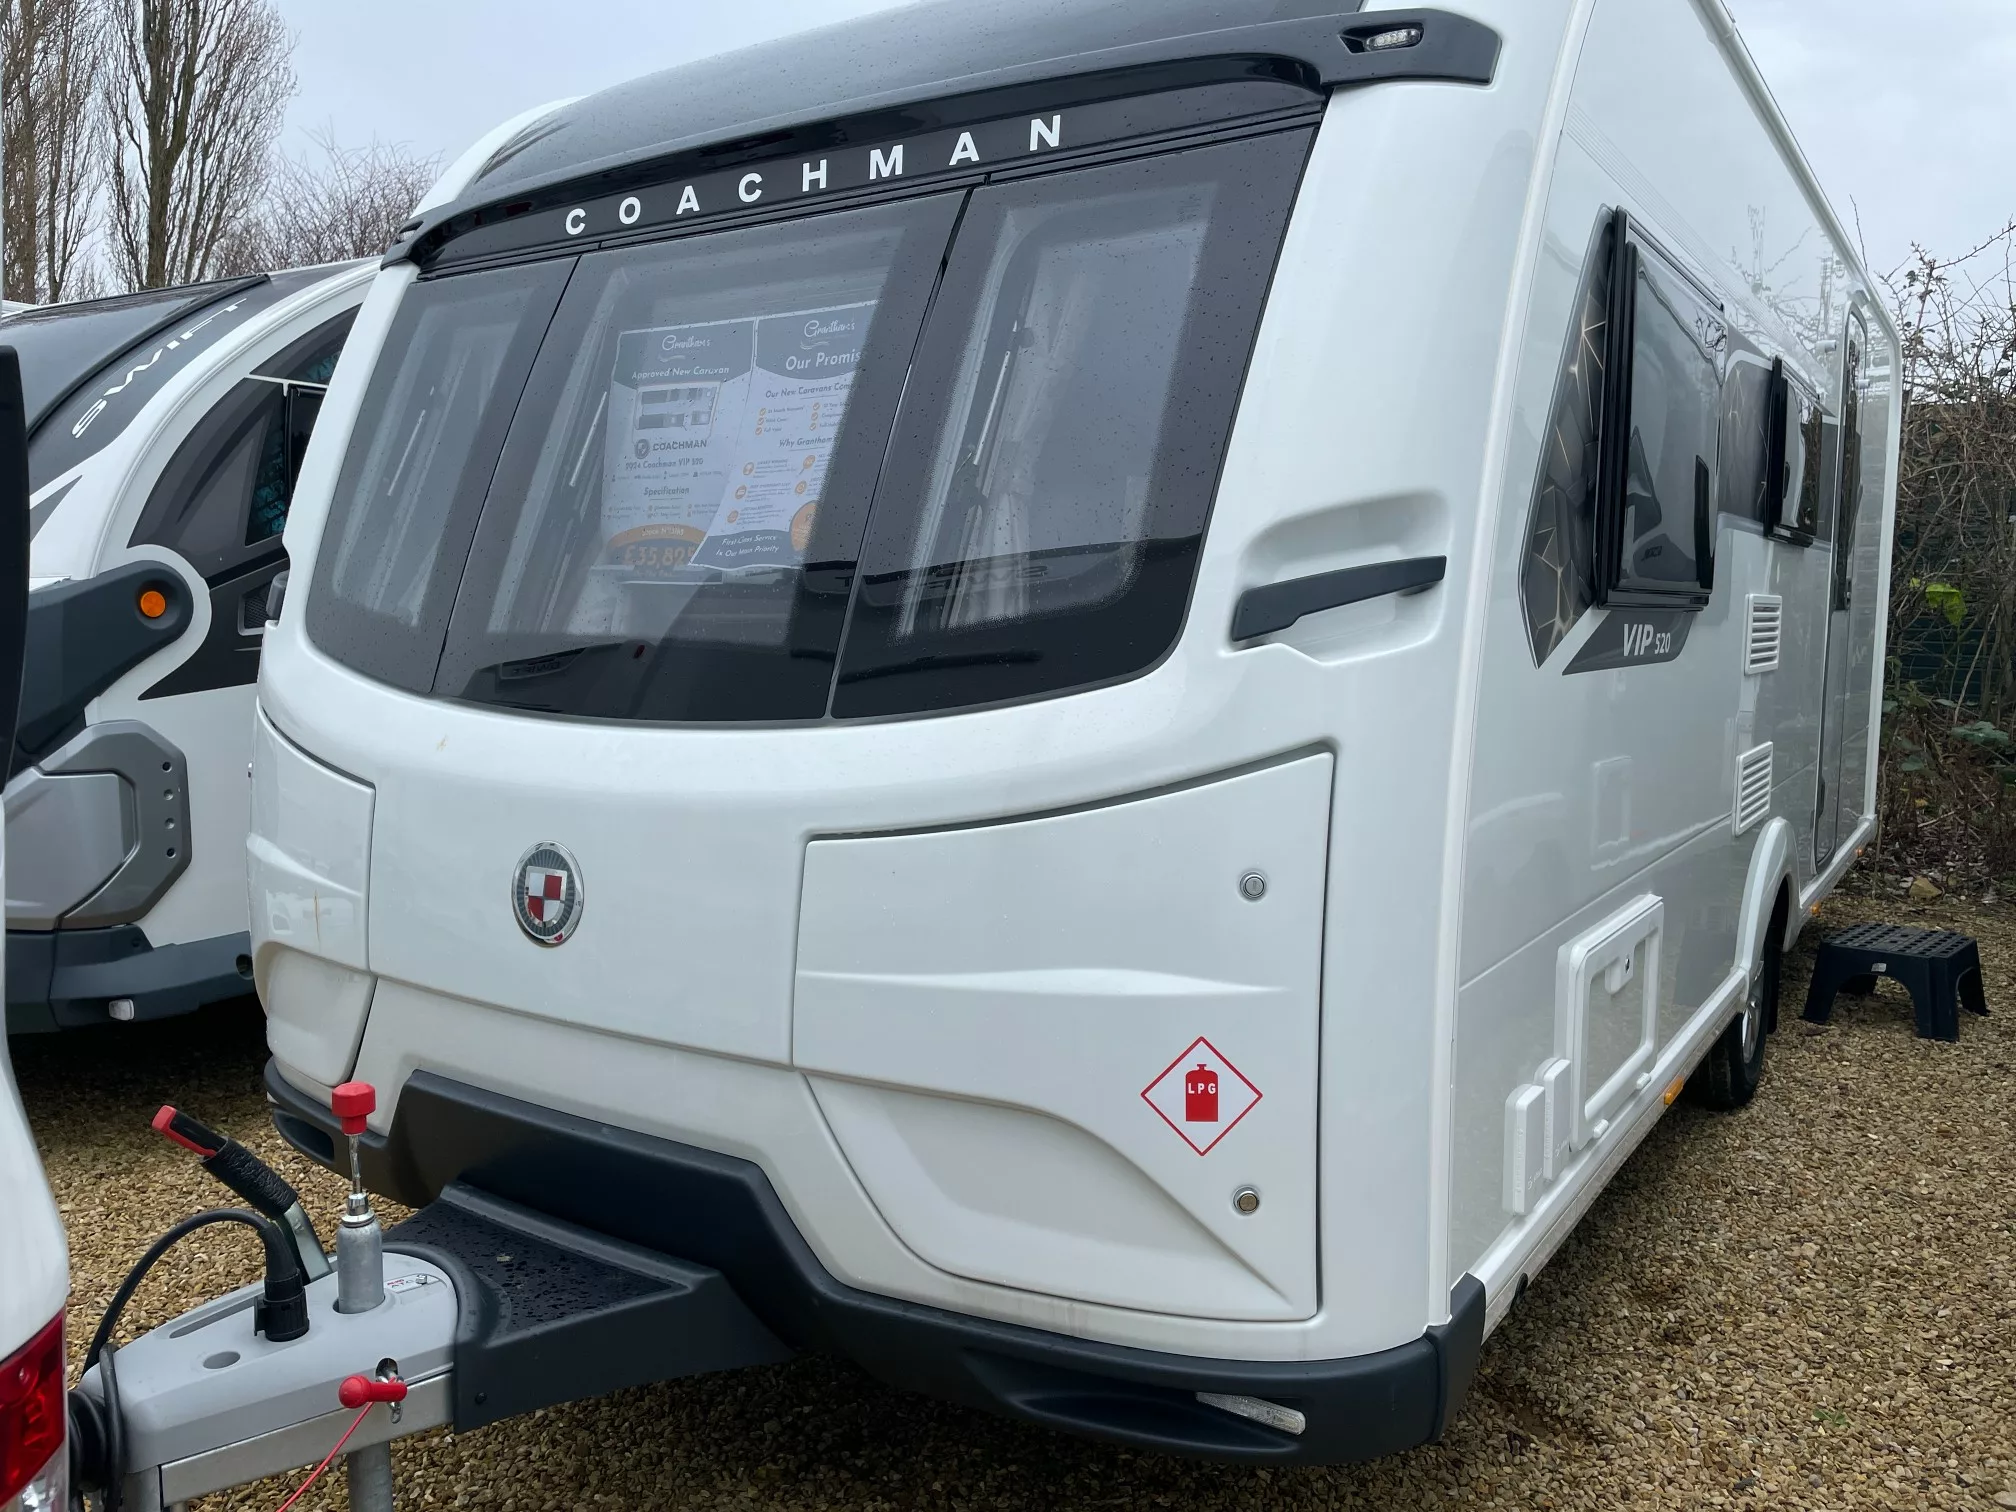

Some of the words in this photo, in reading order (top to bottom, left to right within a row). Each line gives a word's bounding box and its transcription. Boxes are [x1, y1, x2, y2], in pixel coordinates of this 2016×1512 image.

[565, 114, 1061, 235] COACHMAN
[785, 355, 811, 370] Our
[815, 349, 861, 367] Promis
[72, 298, 247, 439] SWIFT
[632, 367, 671, 380] Approved
[672, 367, 691, 376] New
[693, 366, 730, 375] Caravan
[765, 390, 779, 398] Our
[781, 388, 796, 397] New
[834, 382, 850, 391] Com
[652, 440, 707, 451] COACHMAN
[779, 438, 795, 448] Why
[797, 436, 833, 446] Grantham
[678, 458, 690, 467] VIP
[643, 486, 690, 497] Specification
[754, 545, 779, 553] Priority
[1623, 623, 1654, 657] VIP
[1654, 632, 1671, 655] 520
[1187, 1082, 1217, 1095] LPG
